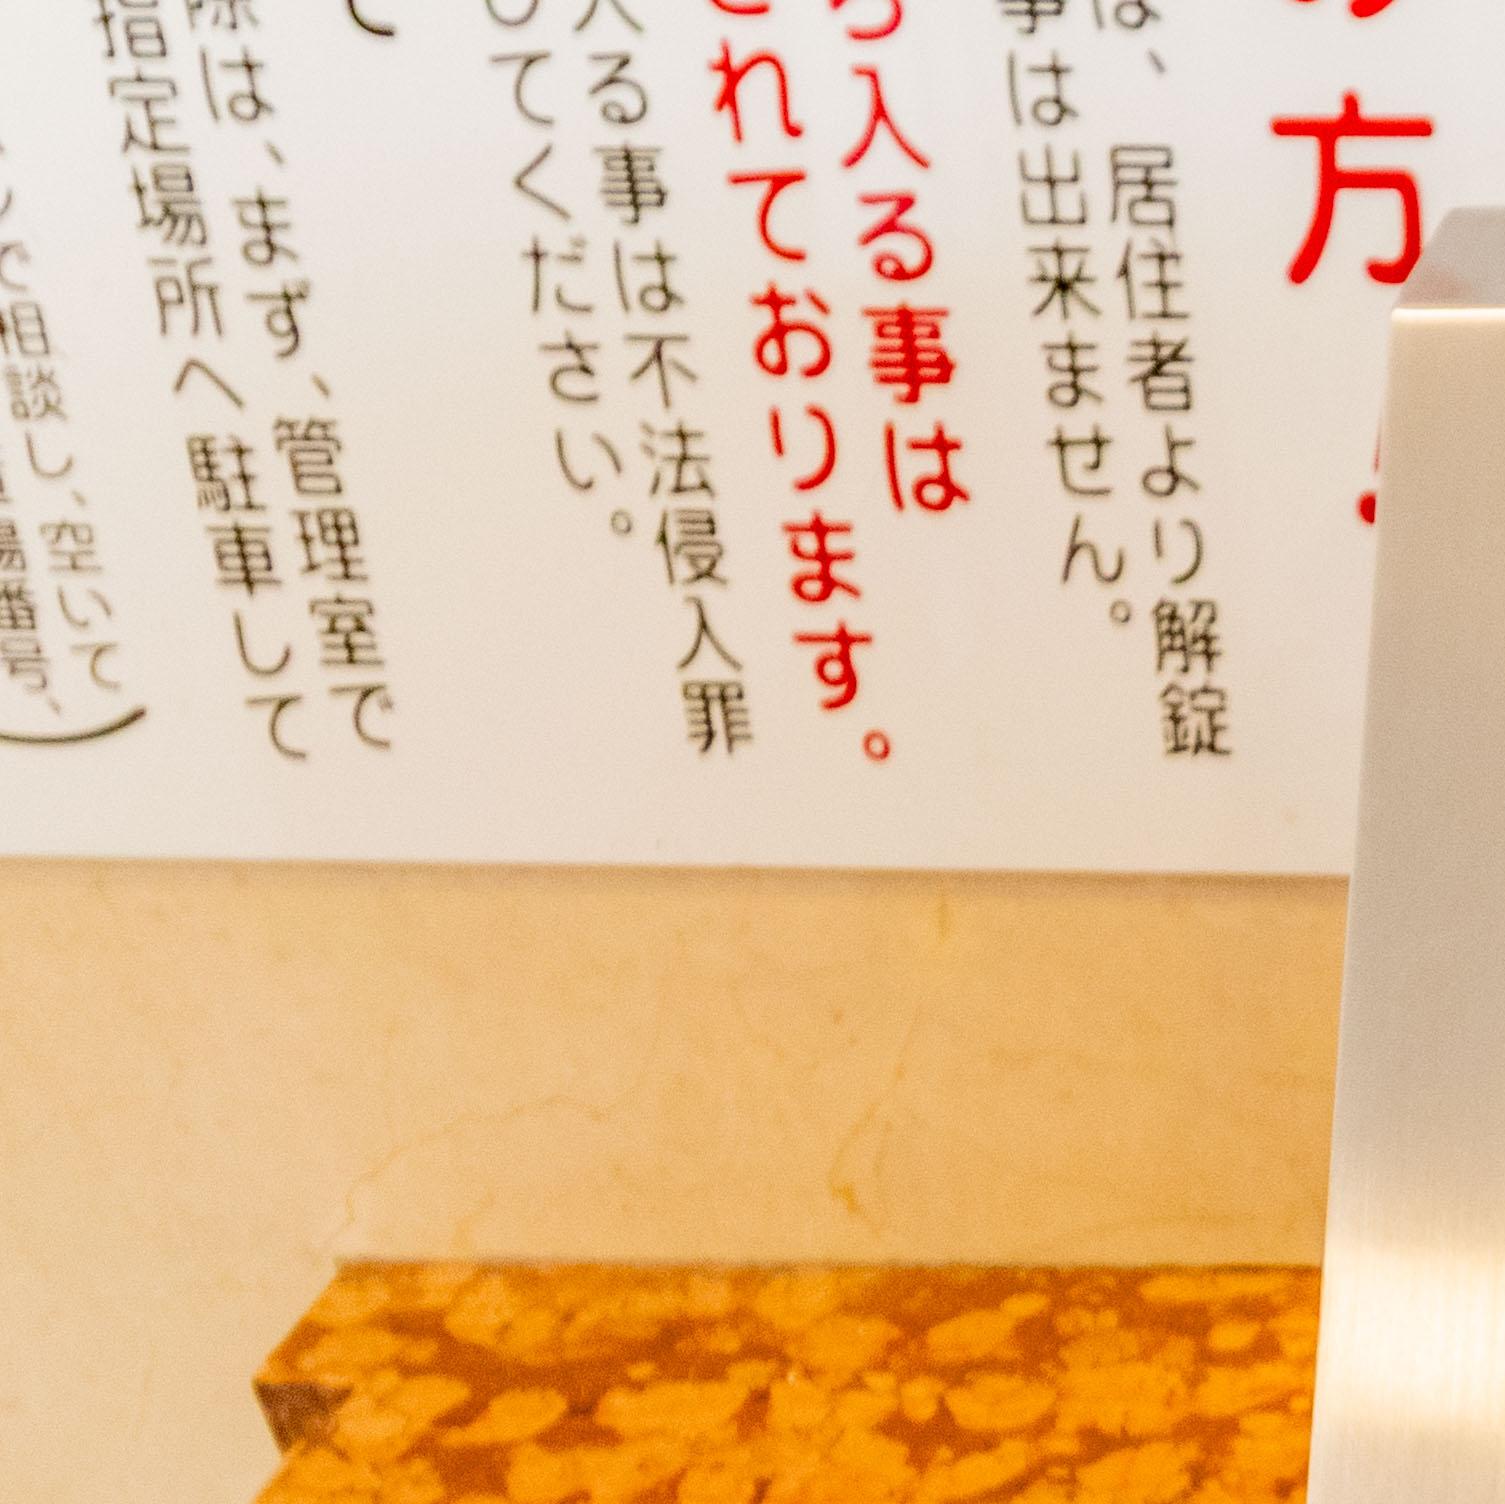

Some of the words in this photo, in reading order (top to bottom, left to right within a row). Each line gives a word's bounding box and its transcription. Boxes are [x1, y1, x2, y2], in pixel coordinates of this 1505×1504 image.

[708, 0, 891, 762] れております。
